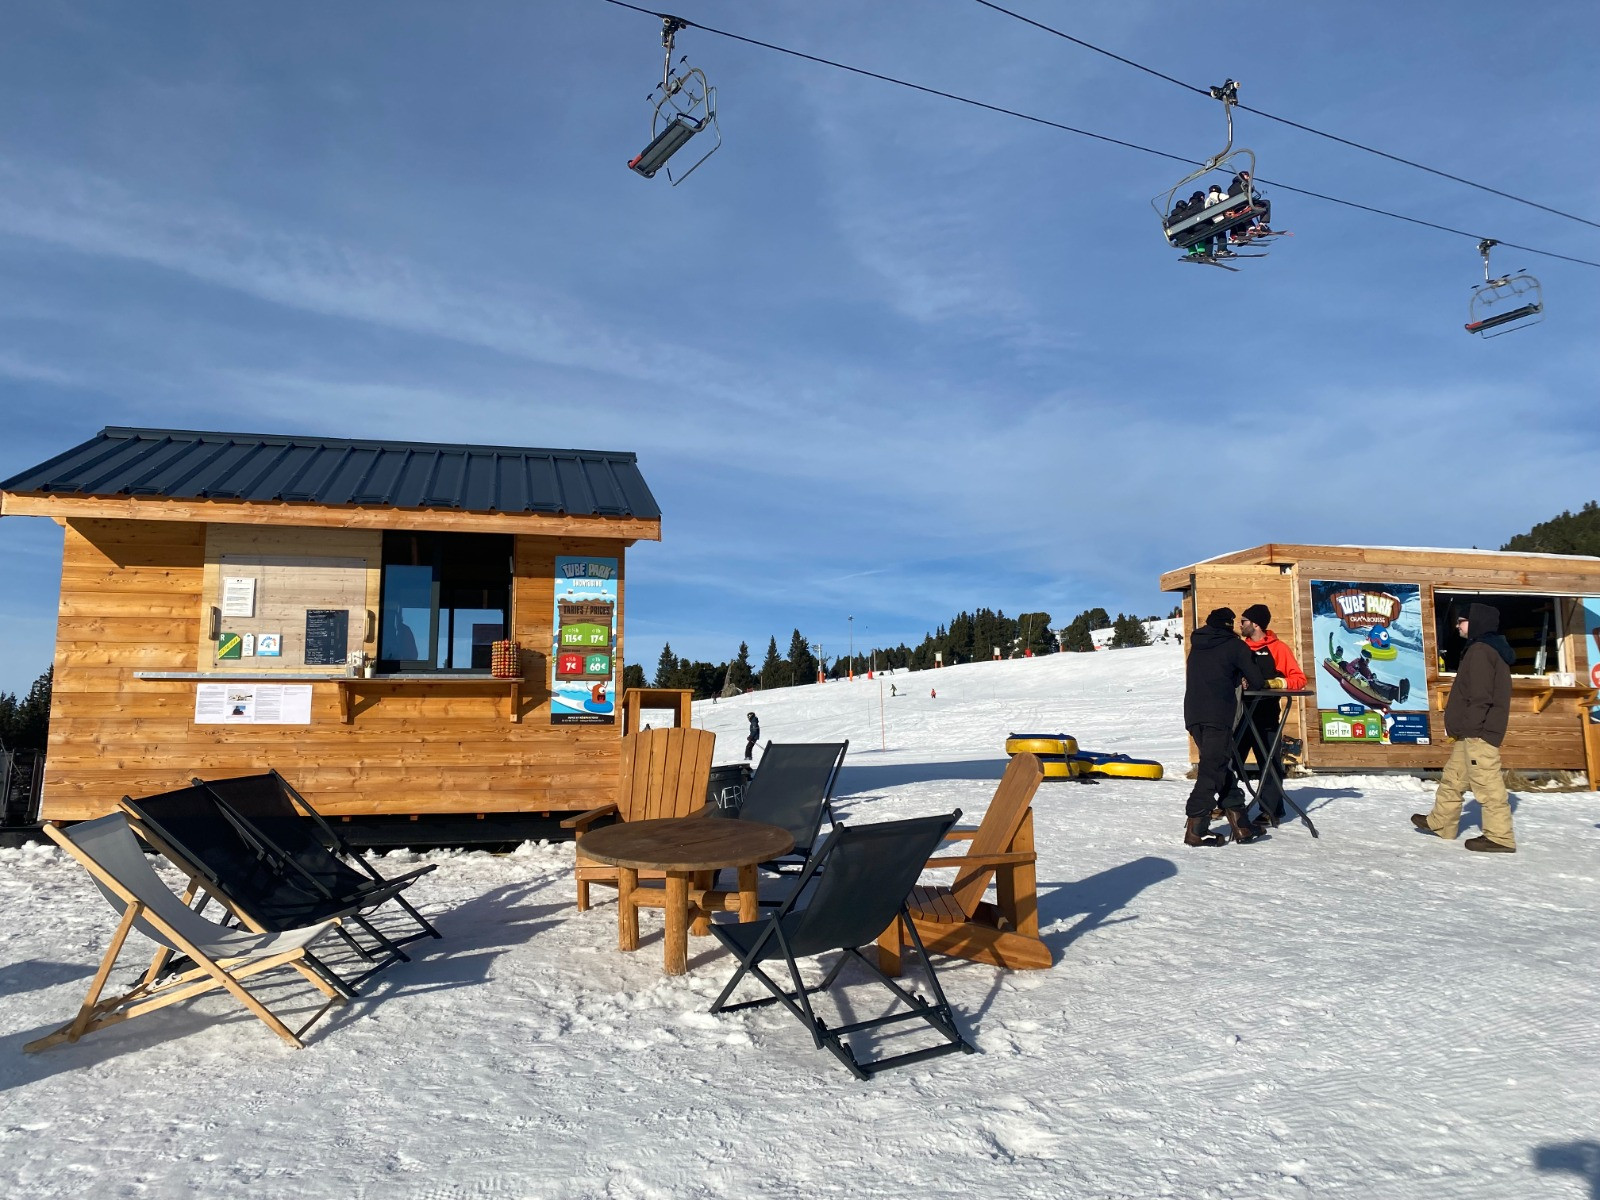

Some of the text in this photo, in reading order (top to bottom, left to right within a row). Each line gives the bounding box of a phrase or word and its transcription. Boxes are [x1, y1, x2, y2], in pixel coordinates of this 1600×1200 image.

[562, 563, 612, 580] TUBE PARK
[564, 605, 583, 615] TARIFS
[590, 606, 611, 615] PRICES
[1337, 594, 1394, 617] TUBE PARK
[590, 635, 604, 643] 17€
[566, 662, 577, 671] 7€
[590, 663, 606, 671] 60€
